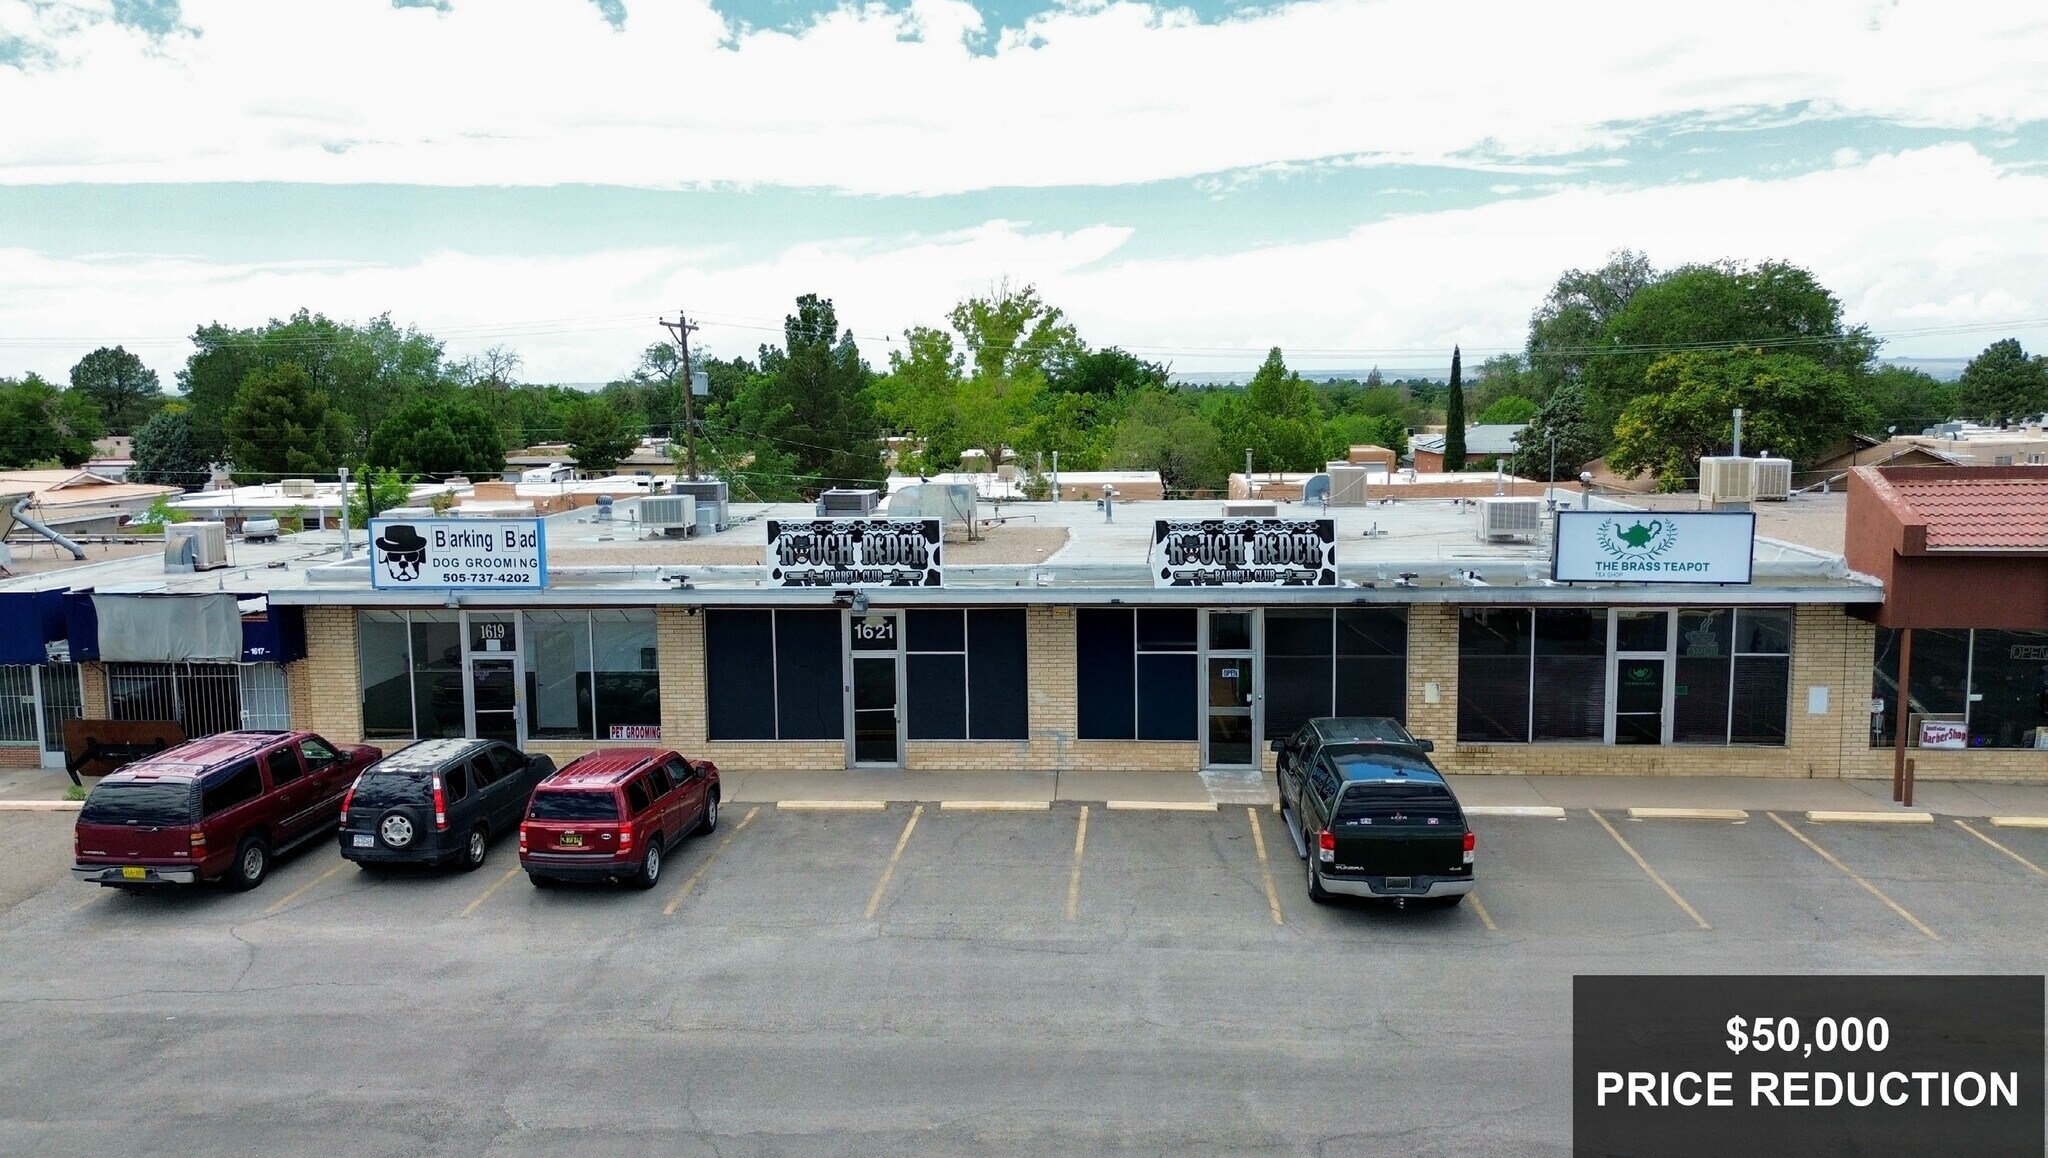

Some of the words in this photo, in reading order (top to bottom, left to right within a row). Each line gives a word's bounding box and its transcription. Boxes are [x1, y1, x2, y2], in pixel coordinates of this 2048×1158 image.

[435, 529, 493, 552] Barking
[505, 529, 536, 548] Bad
[433, 558, 460, 568] DOG
[465, 558, 538, 568] GROOMING
[1595, 561, 1618, 571] THE
[1621, 561, 1661, 571] BRASS
[1664, 562, 1710, 572] TEAPOT
[443, 573, 530, 583] 505-737-4202
[824, 570, 860, 583] BARBELL
[862, 570, 884, 583] CLUB
[1214, 569, 1251, 582] BARBELL
[1254, 569, 1276, 582] CLUB
[480, 624, 505, 639] 1619
[854, 624, 893, 639] 1621
[250, 647, 265, 655] 1617
[611, 726, 624, 738] PET
[626, 726, 661, 738] GROOMING
